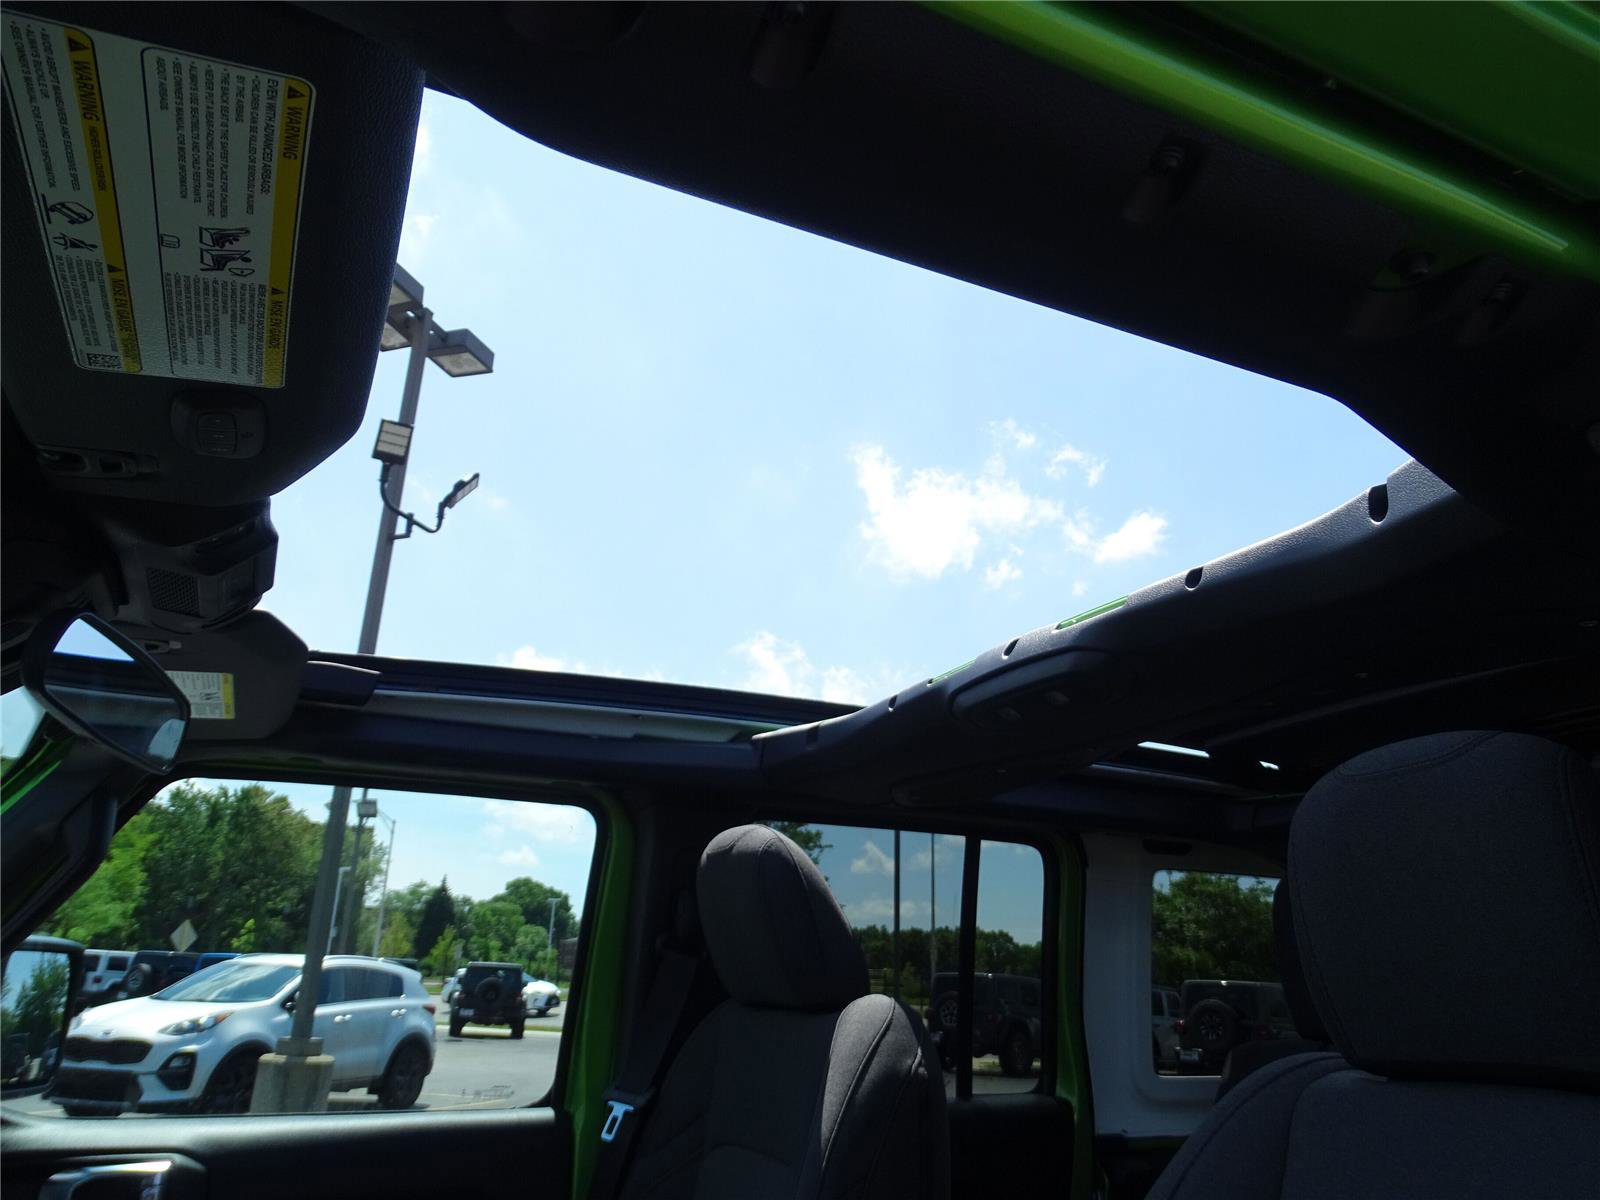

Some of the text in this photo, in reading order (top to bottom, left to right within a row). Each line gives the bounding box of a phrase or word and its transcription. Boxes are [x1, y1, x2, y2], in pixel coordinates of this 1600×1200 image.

[155, 56, 166, 81] ABOUT
[172, 60, 182, 75] SEE
[188, 63, 198, 92] ALWAYS
[204, 67, 213, 92] NEVER
[220, 71, 229, 86] THE
[72, 57, 100, 122] WARNING
[189, 91, 198, 105] USE
[204, 90, 214, 105] PUT
[220, 85, 229, 105] BACK
[235, 85, 244, 99] THE
[250, 77, 261, 111] CHILDREN
[265, 77, 278, 101] EVEN
[174, 106, 184, 133] MANUAL
[220, 104, 229, 121] SEAT
[249, 110, 259, 126] CAN
[264, 101, 277, 122] WITH
[59, 125, 70, 139] AND
[176, 132, 185, 146] FOR
[220, 127, 229, 140] THE
[281, 105, 303, 160] WARNING
[190, 139, 200, 153] AND
[248, 133, 258, 155] KILLED
[261, 122, 275, 162] ADVANCED
[176, 145, 186, 163] MORE
[205, 150, 214, 168] CHILD
[220, 140, 229, 164] SAFEST
[191, 152, 200, 171] CHILD
[206, 167, 215, 182] SEAT
[246, 163, 256, 193] SERIOUSLY
[220, 180, 228, 193] FOR
[110, 276, 127, 298] MISE
[270, 299, 284, 316] MISE
